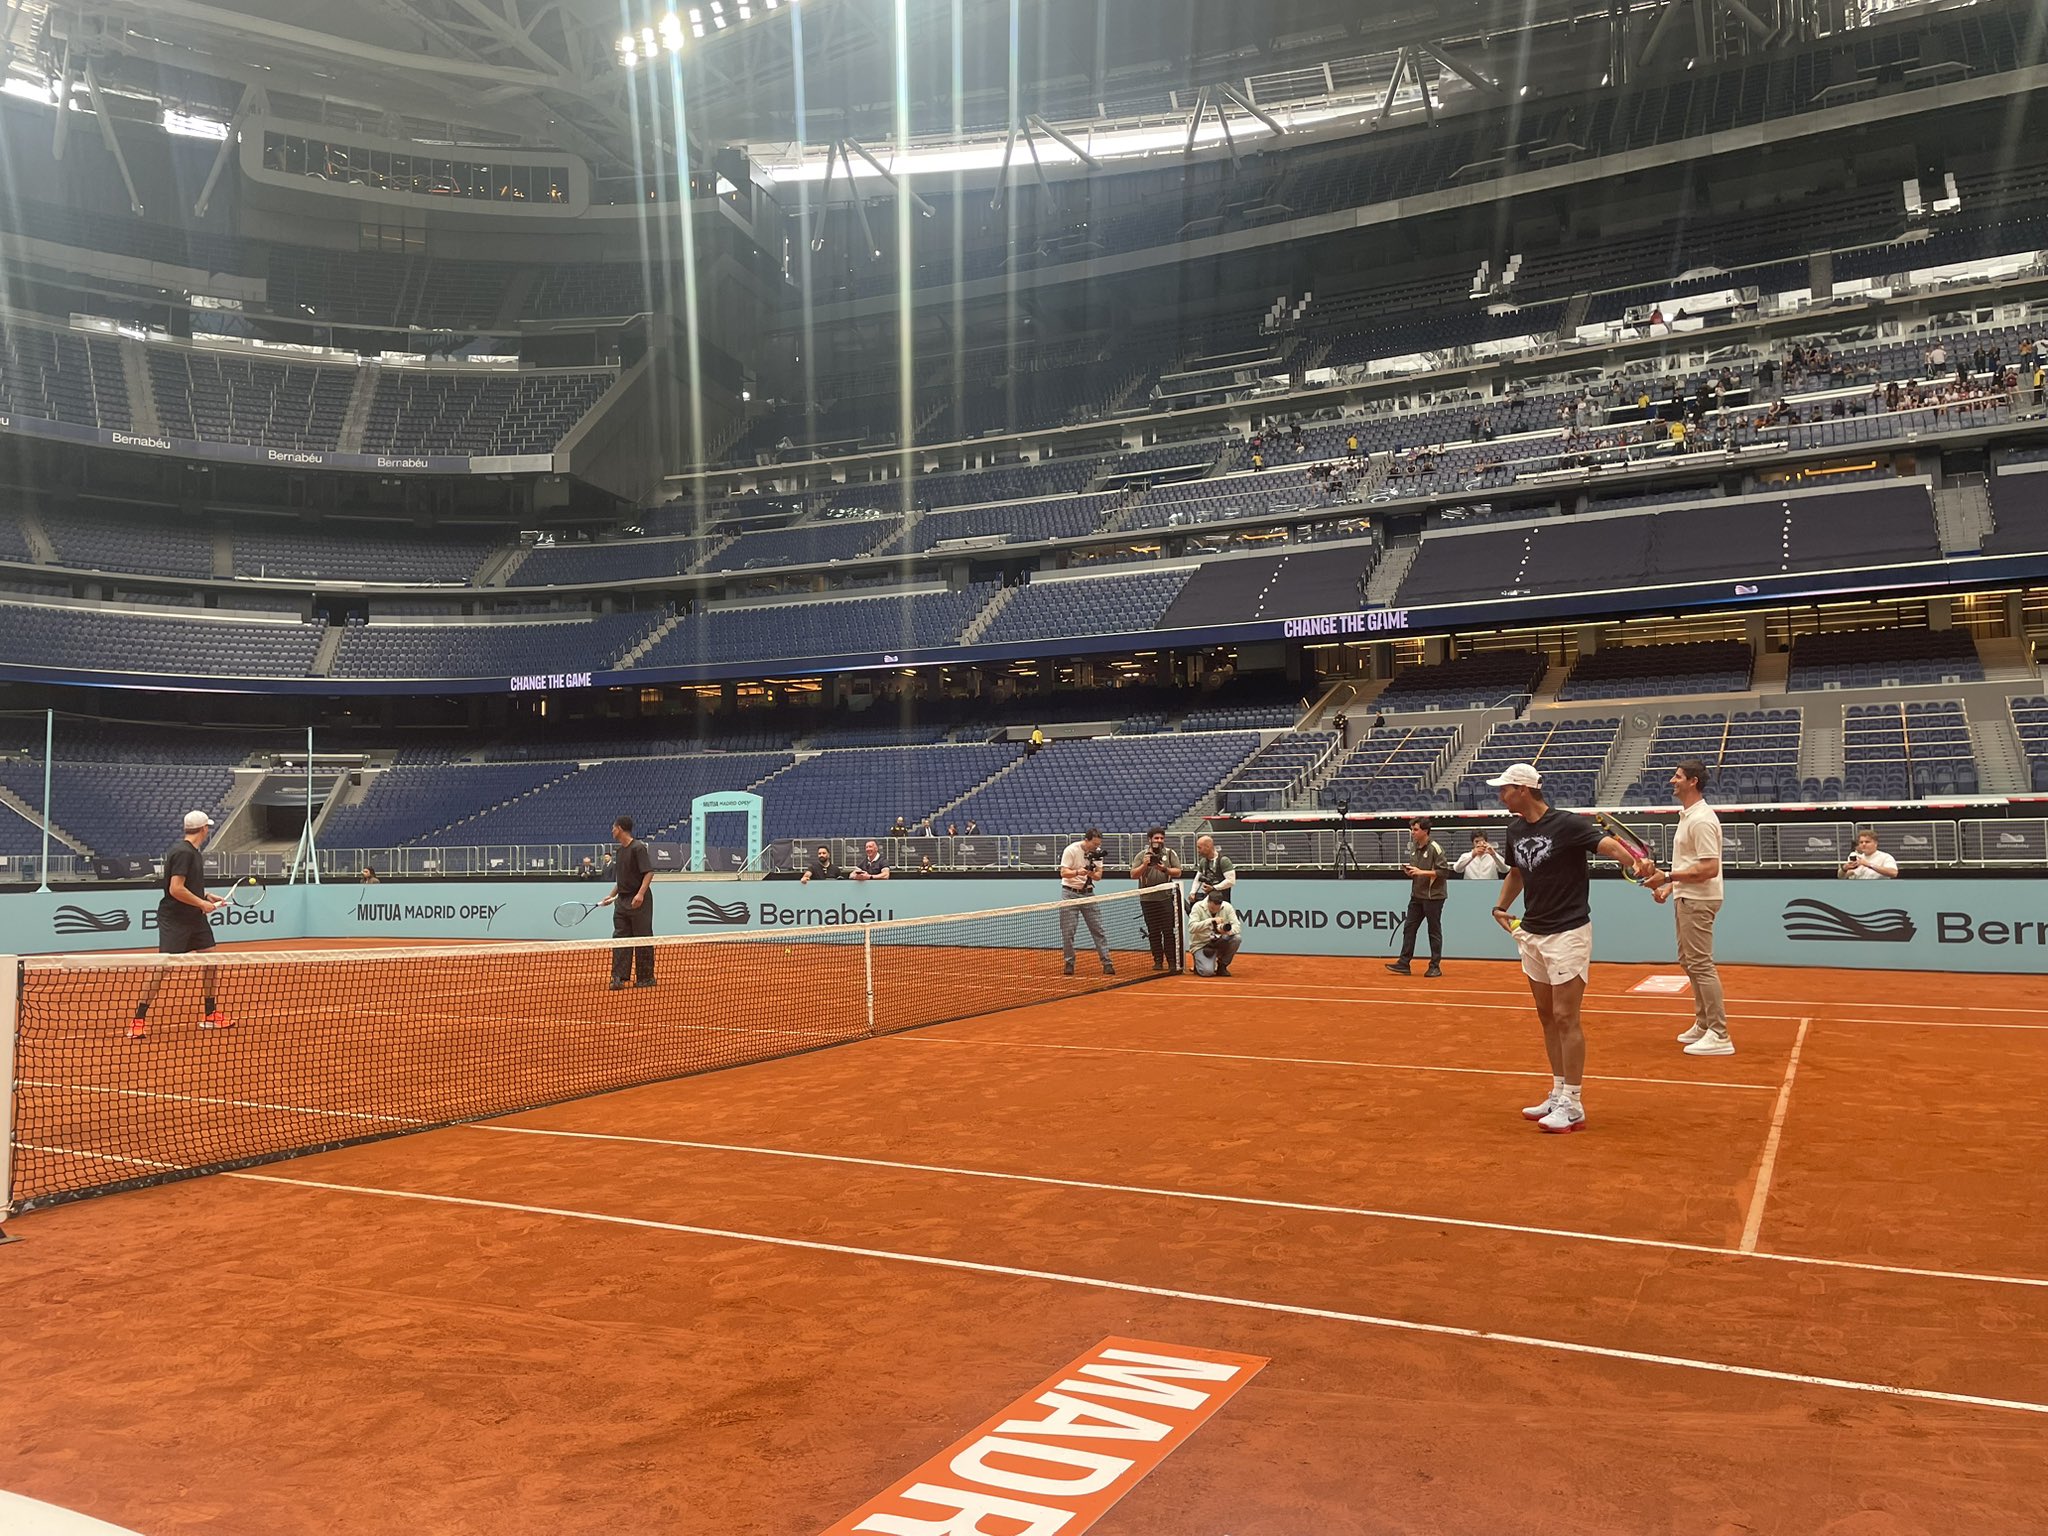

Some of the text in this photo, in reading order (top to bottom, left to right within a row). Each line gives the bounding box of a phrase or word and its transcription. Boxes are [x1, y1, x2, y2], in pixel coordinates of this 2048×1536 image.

[112, 432, 171, 449] Bernabéu
[268, 449, 323, 463] Bernabéu
[377, 457, 428, 468] Bernabéu
[1284, 610, 1409, 638] CHANGE THE GAME
[510, 672, 592, 691] CHANGE THE GAME
[142, 905, 274, 930] Babéu
[357, 904, 498, 921] MUTUA MADRID OPEN
[760, 903, 893, 925] Bernabéu
[1236, 909, 1407, 930] MADRID OPEN
